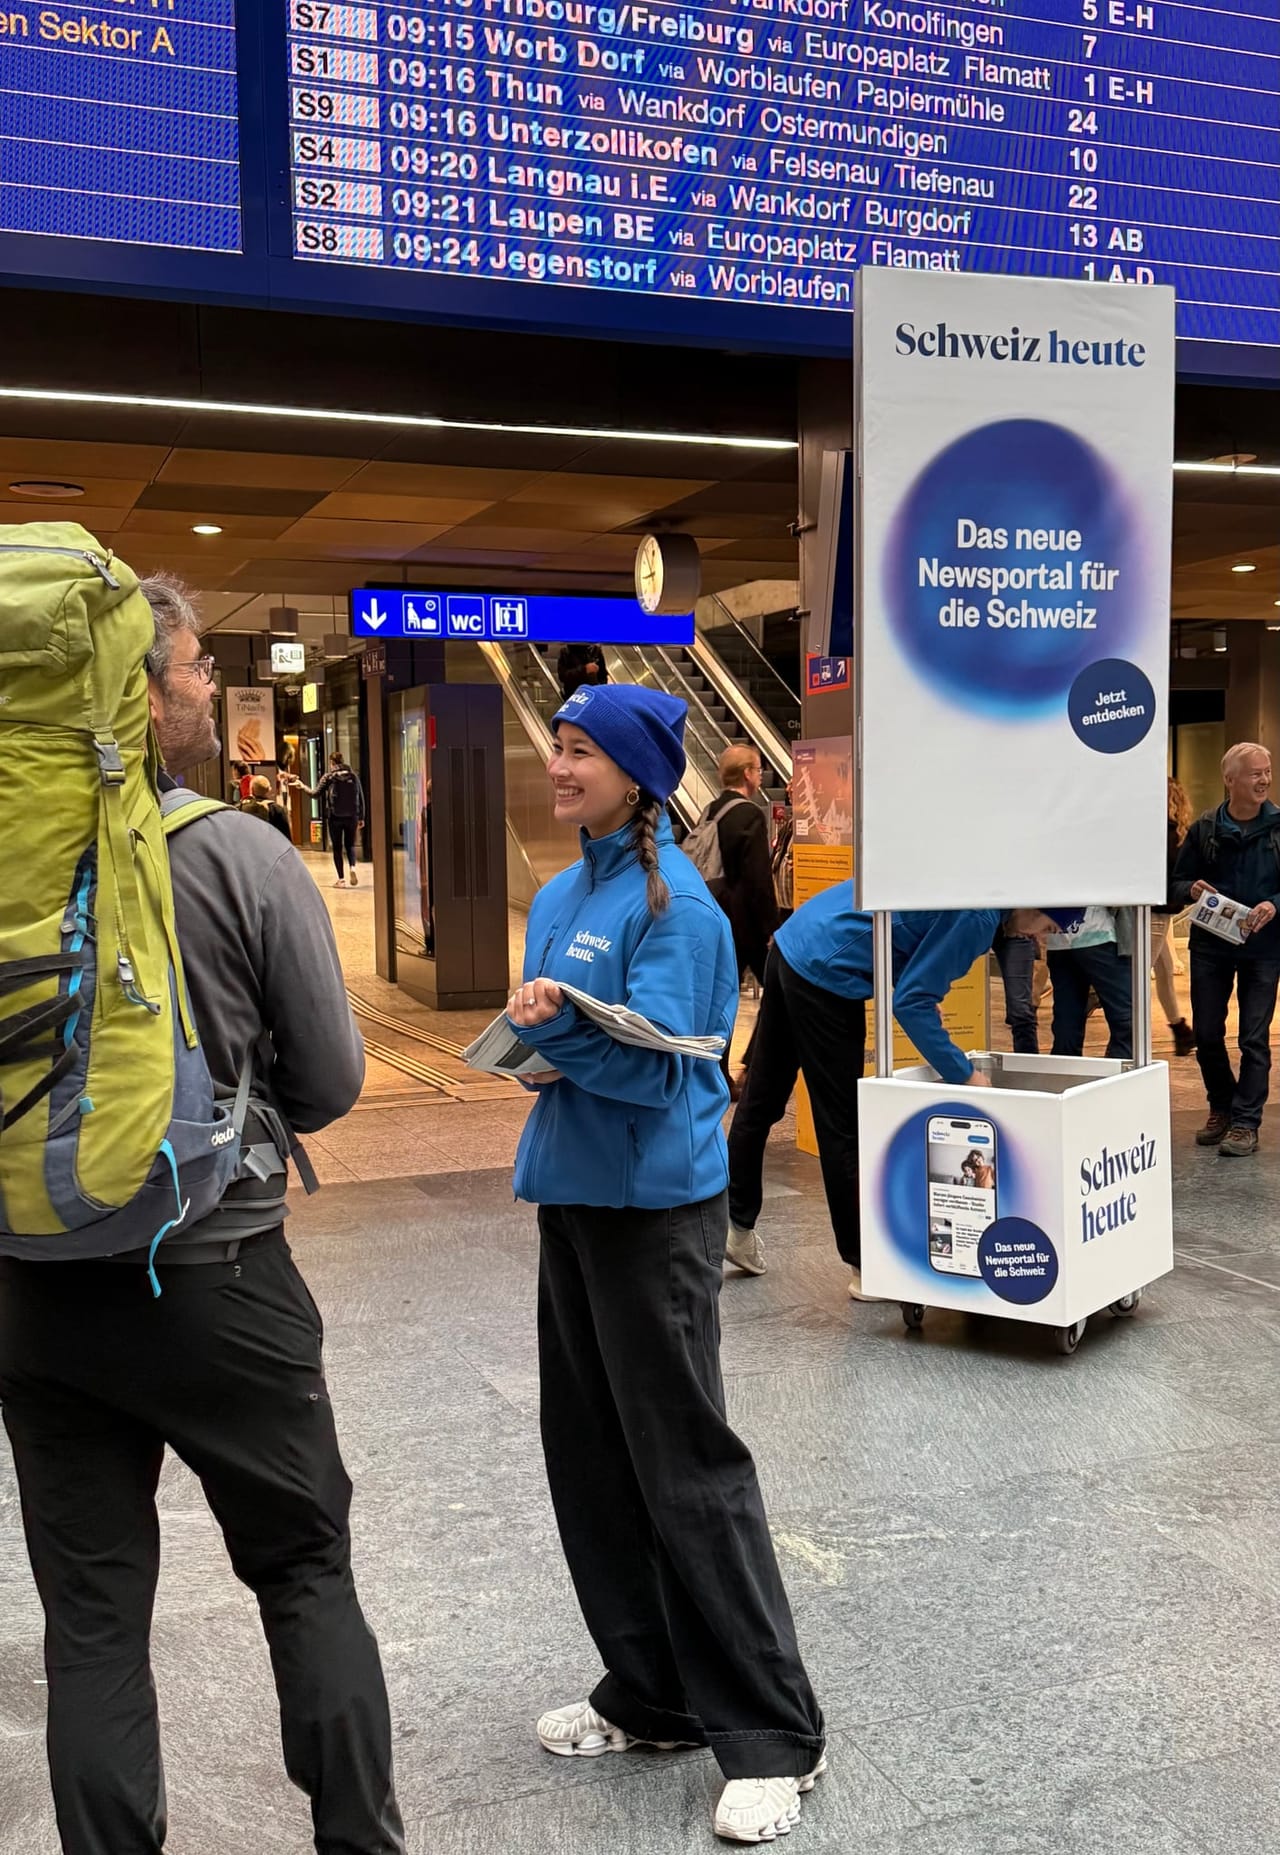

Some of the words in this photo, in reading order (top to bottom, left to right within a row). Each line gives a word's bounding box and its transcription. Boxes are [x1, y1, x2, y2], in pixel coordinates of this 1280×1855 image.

[39, 11, 142, 51] Sektor
[151, 27, 175, 56] A
[864, 1, 1003, 48] Konolfingen
[1082, 34, 1098, 58] 7
[1082, 0, 1098, 21] 5
[1108, 1, 1154, 30] E-H
[296, 3, 330, 29] S7
[387, 14, 475, 50] 09:15
[484, 27, 567, 63] Worb
[577, 40, 645, 73] Dorf
[659, 63, 685, 80] via
[697, 57, 841, 100] Worblaufen
[857, 80, 1005, 122] Papiermühle
[1068, 109, 1098, 135] 24
[768, 37, 793, 54] via
[805, 32, 950, 76] Europaplatz
[964, 55, 1051, 91] Flamatt
[1084, 73, 1096, 97] 1
[1108, 76, 1154, 105] E-H
[297, 48, 328, 74] S1
[388, 58, 476, 94] 09:16
[485, 70, 563, 105] Thun
[579, 93, 605, 111] via
[618, 87, 746, 129] Wankdorf
[760, 107, 948, 156] Ostermundigen
[1070, 148, 1098, 172] 10
[299, 92, 334, 118] S9
[389, 102, 477, 137] 09:16
[487, 113, 718, 166] Unterzollikofen
[732, 154, 757, 171] via
[769, 149, 880, 186] Felsenau
[894, 163, 994, 199] Tiefenau
[1068, 185, 1098, 211] 22
[299, 136, 335, 162] S4
[391, 145, 478, 180] 09:20
[488, 156, 621, 197] Langnau
[630, 173, 677, 203] i.E.
[691, 190, 717, 208] via
[729, 184, 851, 222] Wankdorf
[865, 200, 971, 236] Burgdorf
[1070, 223, 1098, 248] 13
[1107, 227, 1144, 252] AB
[300, 181, 337, 207] S2
[392, 188, 476, 224] 09:21
[489, 199, 603, 238] Laupen
[614, 213, 655, 243] BE
[669, 229, 695, 247] via
[707, 223, 857, 265] Europaplatz
[872, 241, 960, 271] Flamatt
[1084, 263, 1096, 281] 1
[1108, 265, 1155, 285] A-D
[302, 225, 338, 251] S8
[393, 232, 481, 267] 09:24
[489, 243, 657, 284] Jegenstorf
[670, 271, 696, 288] via
[709, 264, 850, 302] Worblaufen
[895, 322, 1041, 364] Schweiz
[1048, 330, 1146, 367] heute
[956, 518, 1009, 551] Das
[1015, 526, 1082, 552] neue
[918, 558, 1073, 595] Newsportal
[1080, 562, 1120, 592] für
[451, 614, 482, 631] WC
[939, 598, 981, 629] die
[987, 598, 1097, 630] Schweiz
[1081, 703, 1145, 726] entdecken
[1095, 689, 1127, 707] Jetzt
[565, 943, 595, 962] heute
[573, 930, 612, 952] Schweiz
[1080, 1133, 1157, 1196] Schweiz
[1080, 1190, 1137, 1245] heute
[985, 1253, 1036, 1266] Newsportal
[1036, 1252, 1050, 1263] für
[995, 1242, 1012, 1253] Das
[1013, 1242, 1036, 1252] neue
[994, 1267, 1008, 1278] die
[1008, 1265, 1046, 1277] Schweiz
